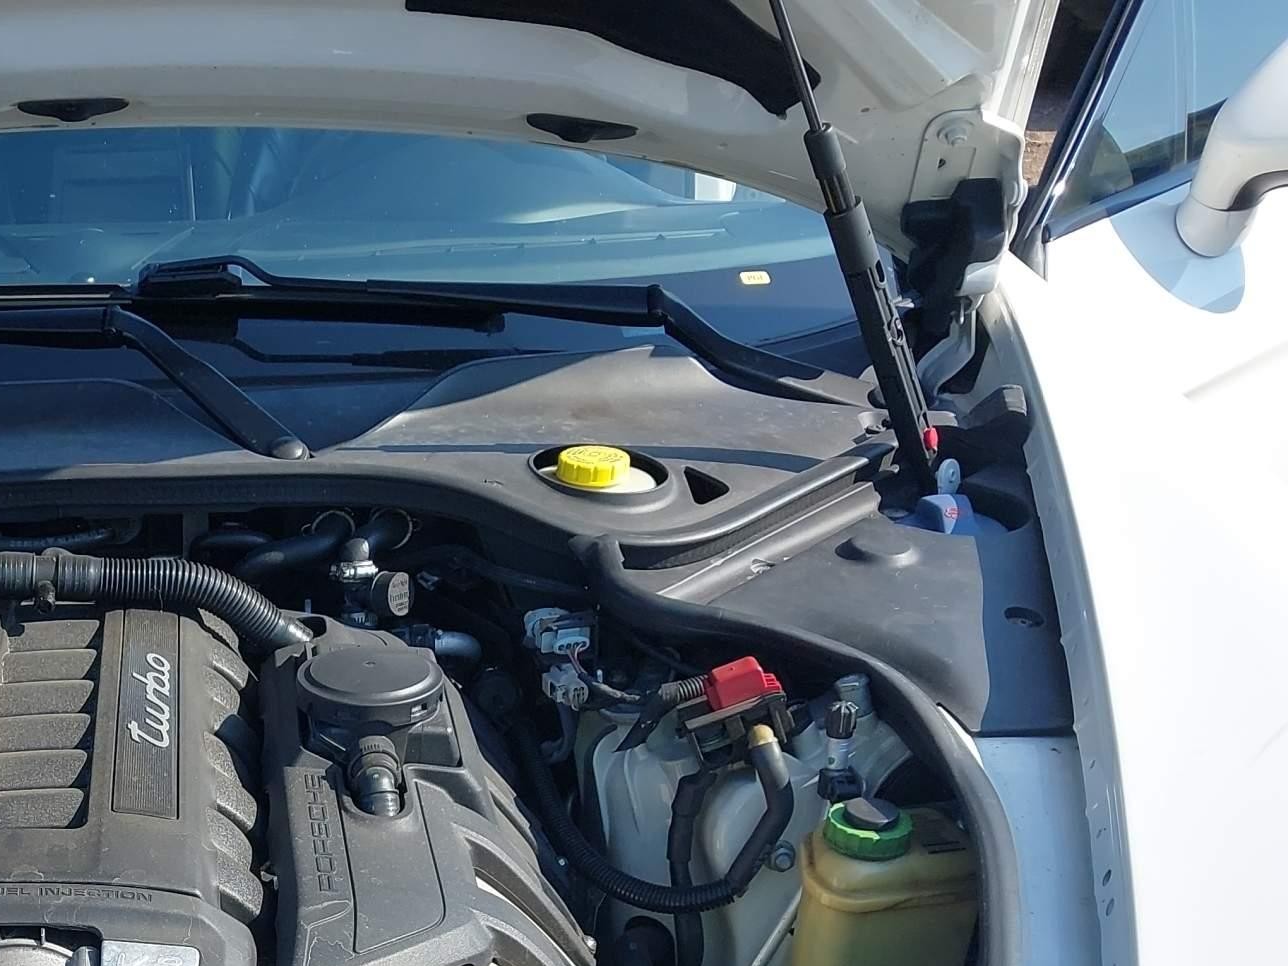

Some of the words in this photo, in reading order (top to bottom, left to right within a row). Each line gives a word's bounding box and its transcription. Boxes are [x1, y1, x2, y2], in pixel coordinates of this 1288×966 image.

[126, 652, 171, 748] turbo
[304, 773, 337, 893] PORSCHE
[39, 887, 153, 903] INJECTION
